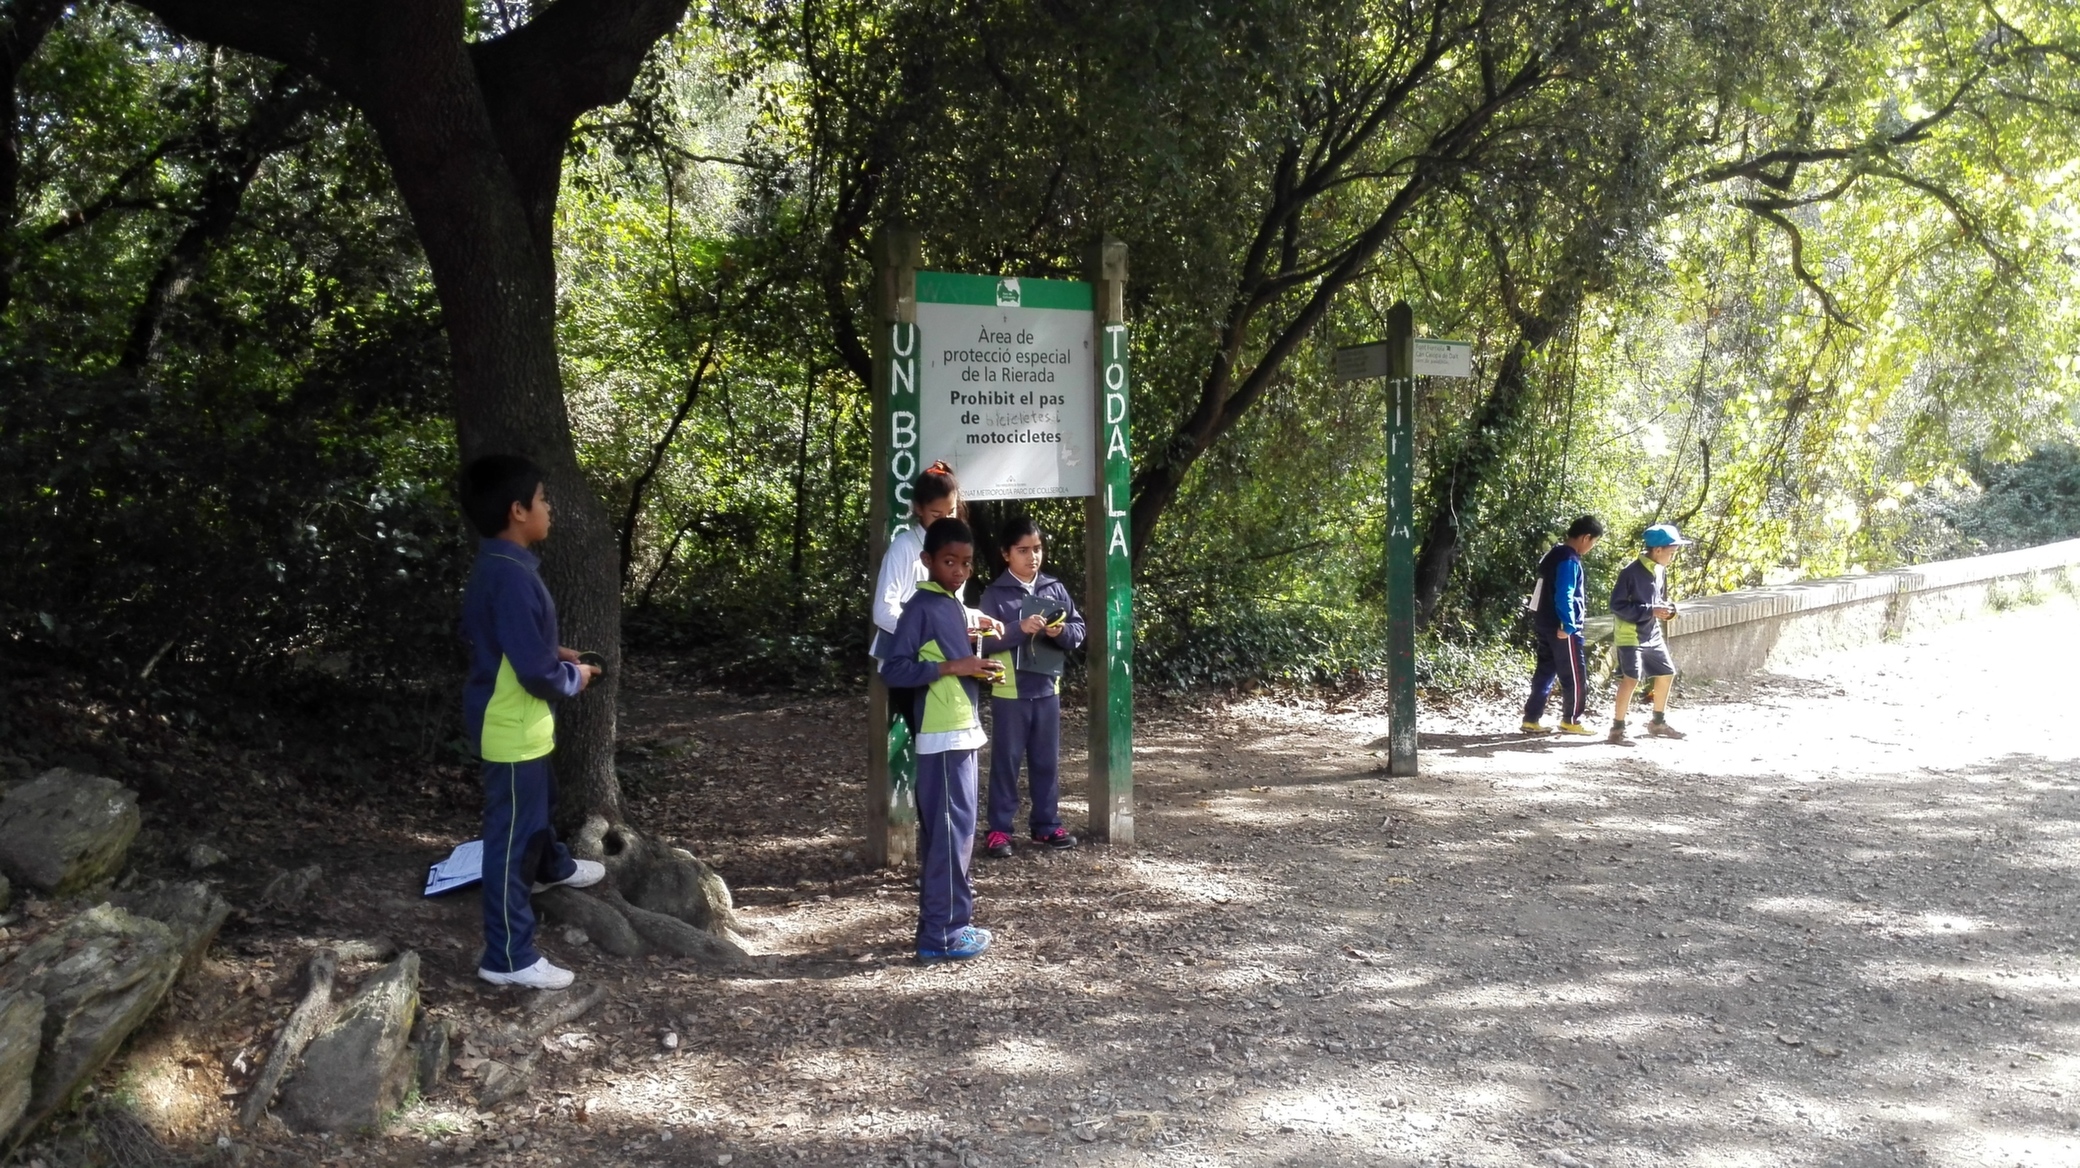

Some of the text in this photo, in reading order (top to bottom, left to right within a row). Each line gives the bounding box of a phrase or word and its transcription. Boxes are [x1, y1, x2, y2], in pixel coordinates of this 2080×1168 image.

[978, 324, 1034, 345] Àrea de
[891, 322, 915, 395] UN
[943, 347, 1071, 367] protecció especial
[961, 366, 1055, 383] de la Rierada
[950, 390, 1065, 409] Prohibit el pas
[961, 410, 980, 425] de
[966, 429, 1061, 444] motocicletes
[1105, 325, 1129, 558] TODA LA
[1013, 487, 1028, 495] PARC
[1037, 486, 1069, 495] COLLSEROLA
